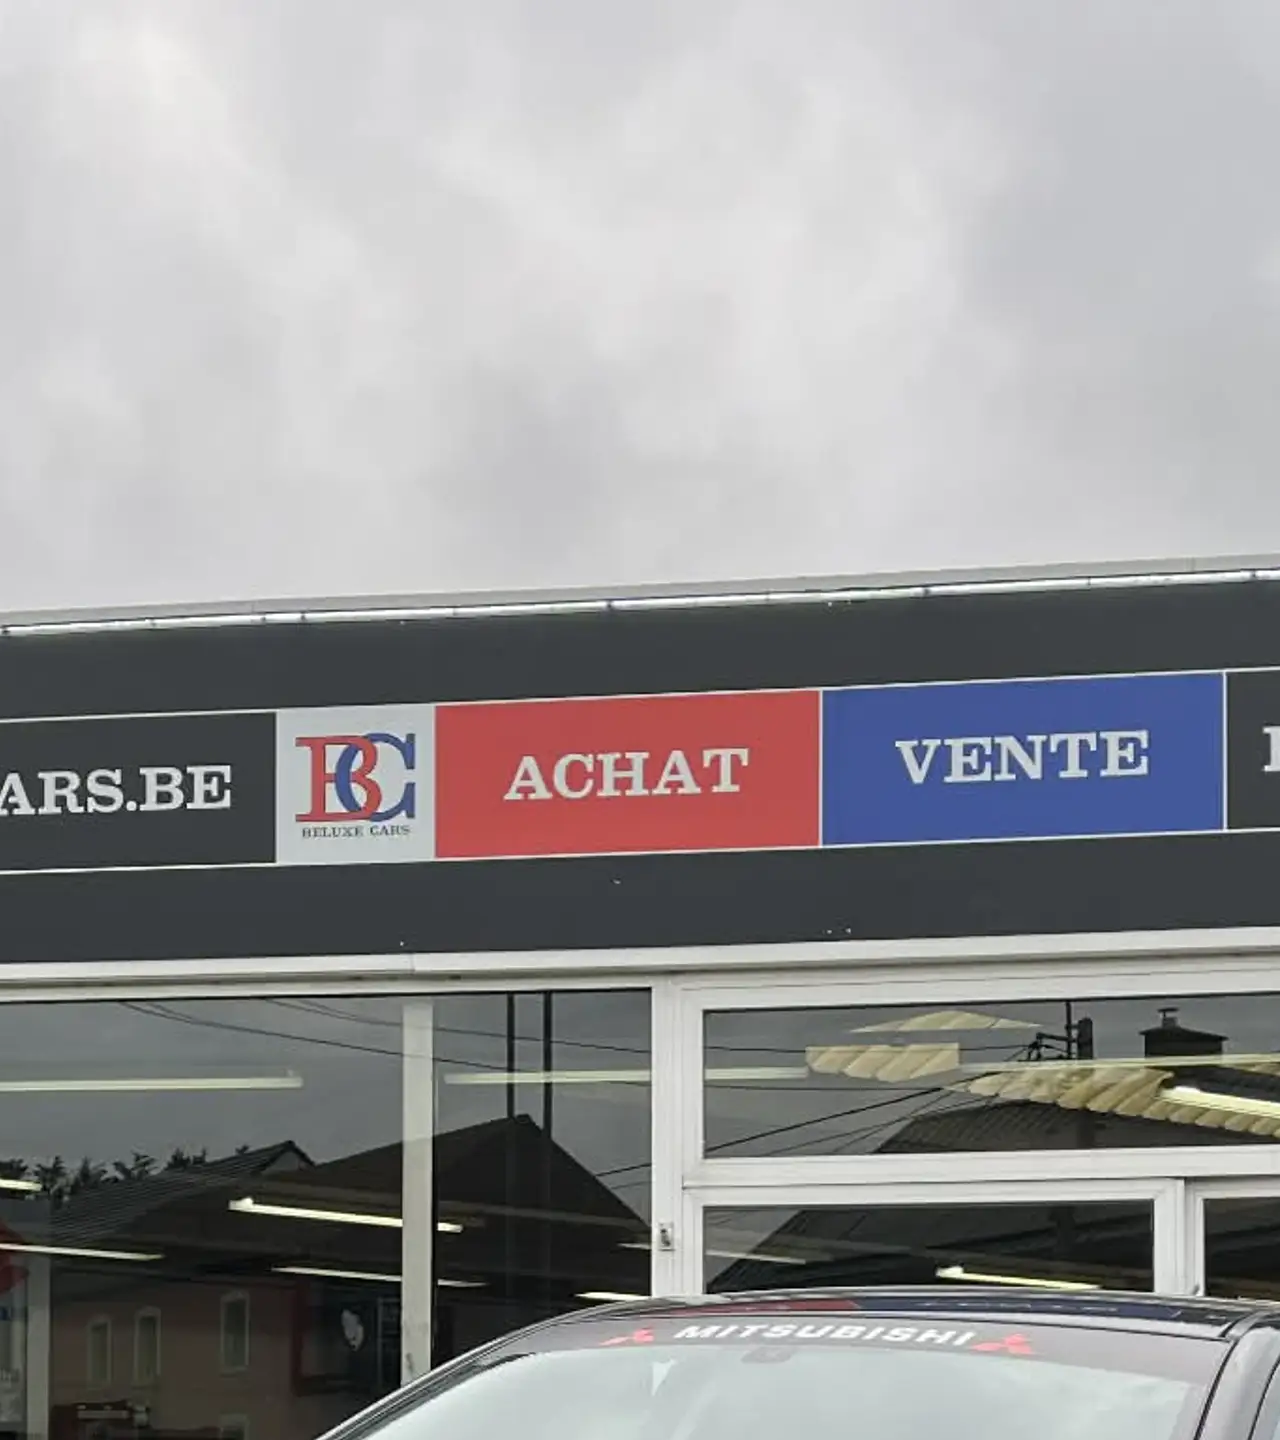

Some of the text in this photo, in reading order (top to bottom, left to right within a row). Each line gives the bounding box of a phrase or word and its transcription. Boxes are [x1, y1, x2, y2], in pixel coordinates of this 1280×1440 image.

[504, 747, 749, 801] ACHAT
[895, 730, 1149, 785] VENTE
[302, 825, 410, 838] BELUXE CARS
[674, 1324, 975, 1346] MITSUBISHI
